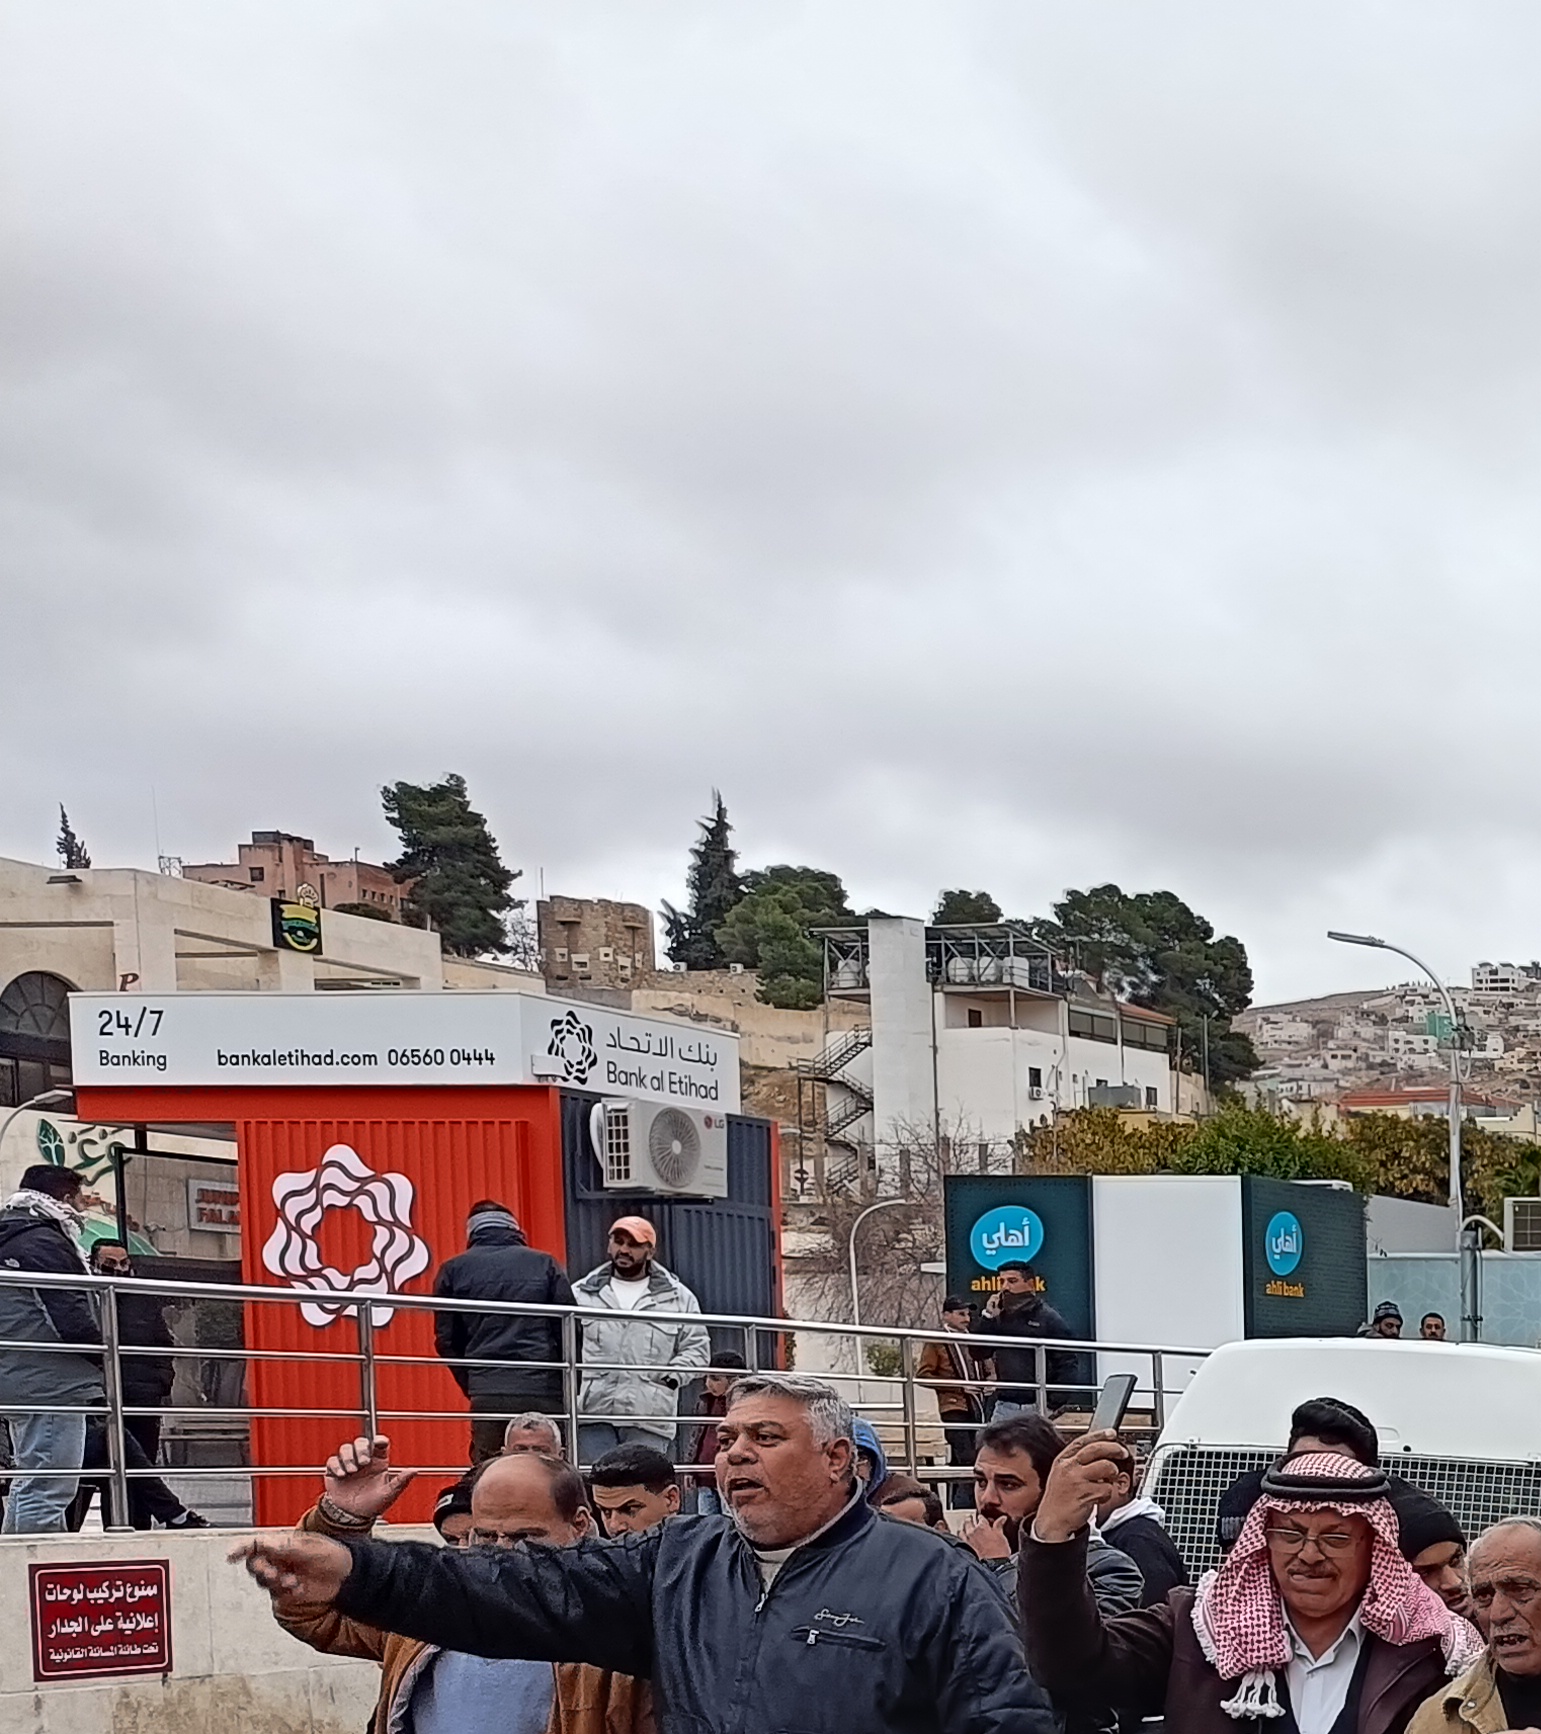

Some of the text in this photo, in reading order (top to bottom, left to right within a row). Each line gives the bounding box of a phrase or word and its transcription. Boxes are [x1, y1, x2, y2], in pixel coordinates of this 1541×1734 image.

[98, 1006, 164, 1038] 24/7
[98, 1050, 168, 1071] Banking
[217, 1048, 496, 1067] bankaletihad.com 06560 0444
[606, 1026, 718, 1072] بنك الاتحاد
[606, 1061, 719, 1101] Bank al Etihad
[714, 1118, 725, 1129] LG
[982, 1217, 1031, 1256] أهلي
[1271, 1224, 1298, 1261] أهلي
[1265, 1281, 1306, 1298] ahli bank
[45, 1579, 158, 1605] ممنوع تركيب لوحات
[47, 1611, 159, 1639] إعلانية على الجدار
[48, 1647, 88, 1663] القانونية
[142, 1642, 159, 1654] تحت
